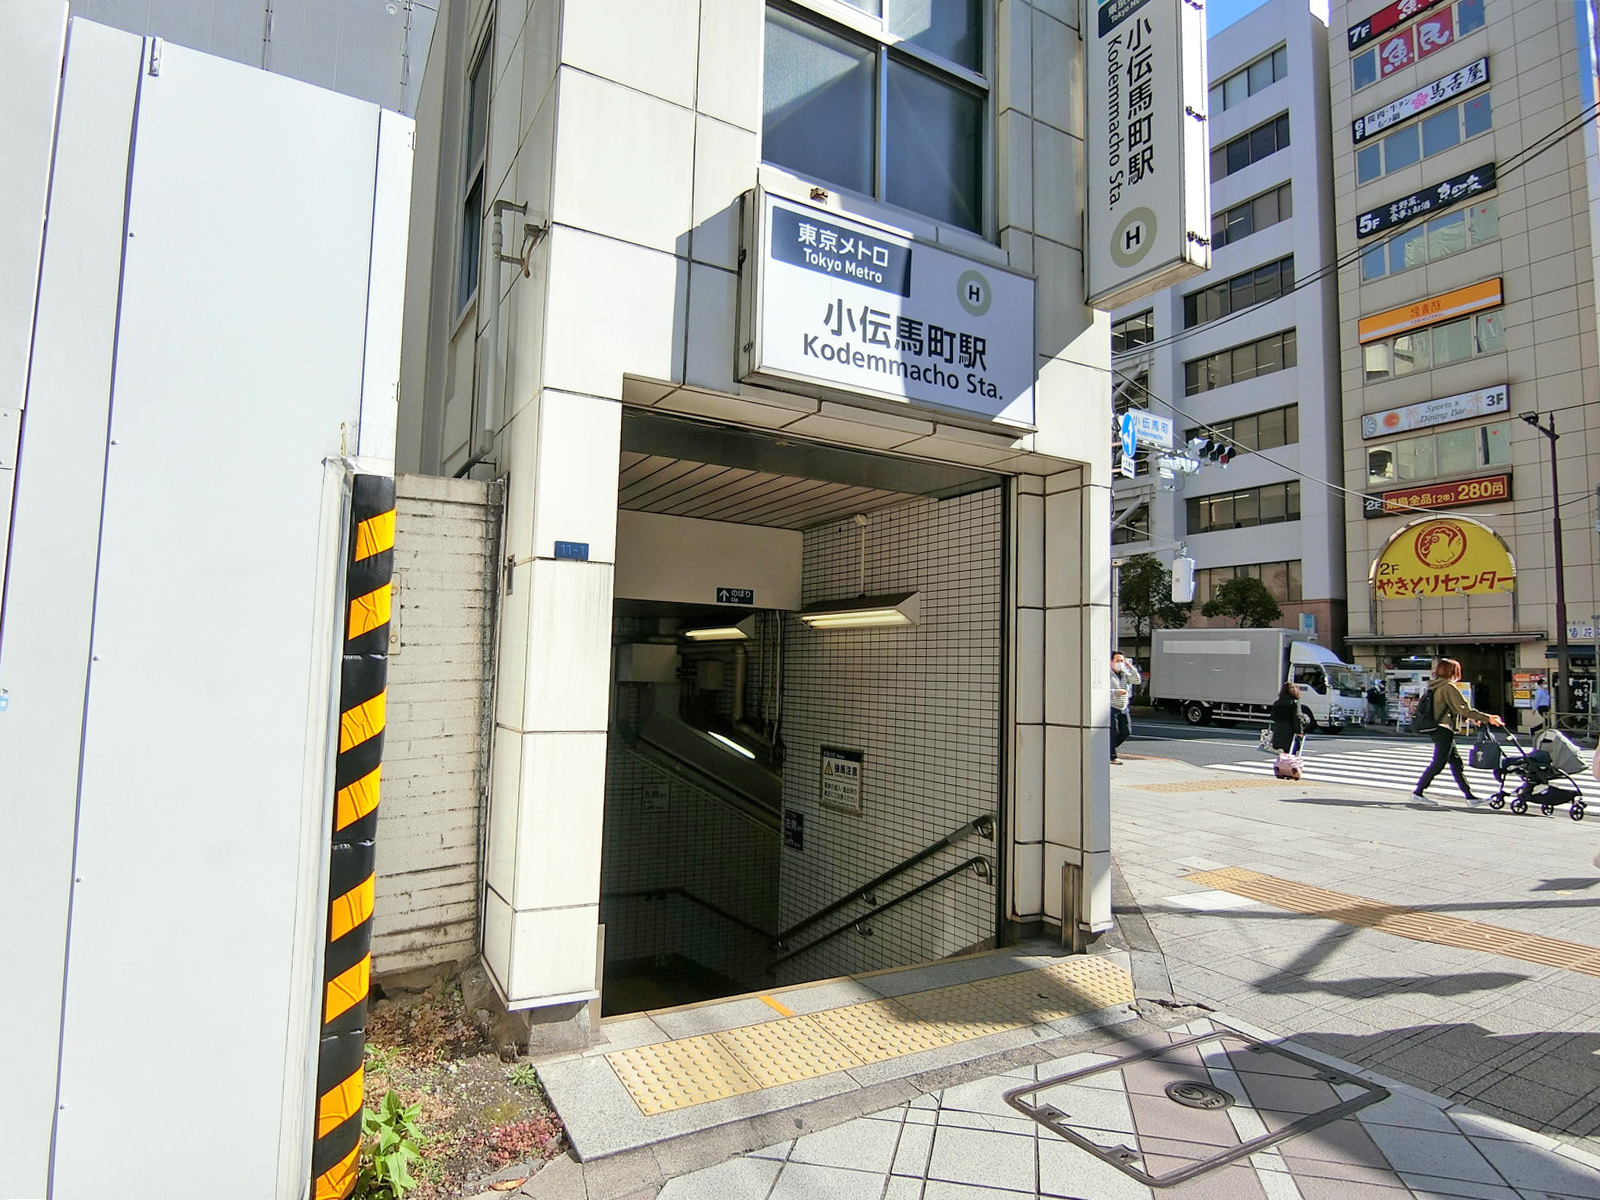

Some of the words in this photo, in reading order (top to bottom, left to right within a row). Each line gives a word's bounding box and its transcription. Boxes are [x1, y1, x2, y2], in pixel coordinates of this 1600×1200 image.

[1350, 24, 1370, 43] 7F
[1108, 34, 1124, 167] Kodemmacho
[1127, 18, 1154, 186] 小伝馬町駅
[1354, 120, 1364, 139] 6F
[1109, 170, 1123, 211] Sta.
[1360, 214, 1380, 233] 5F
[798, 222, 889, 267] 東京メトロ
[1126, 225, 1140, 250] H
[803, 247, 842, 272] Tokyo
[845, 260, 883, 284] Metro
[968, 284, 980, 302] H
[823, 298, 987, 372] 小伝馬町駅
[803, 333, 960, 390] Kodemmacho
[966, 373, 1003, 400] Sta.
[1425, 401, 1453, 413] Sports
[1486, 393, 1504, 407] 3F
[1420, 411, 1448, 423] Dining
[1450, 407, 1467, 418] Bar
[1458, 481, 1504, 500] 280円
[1379, 563, 1399, 576] 2F
[1377, 571, 1514, 596] やきとりセンター
